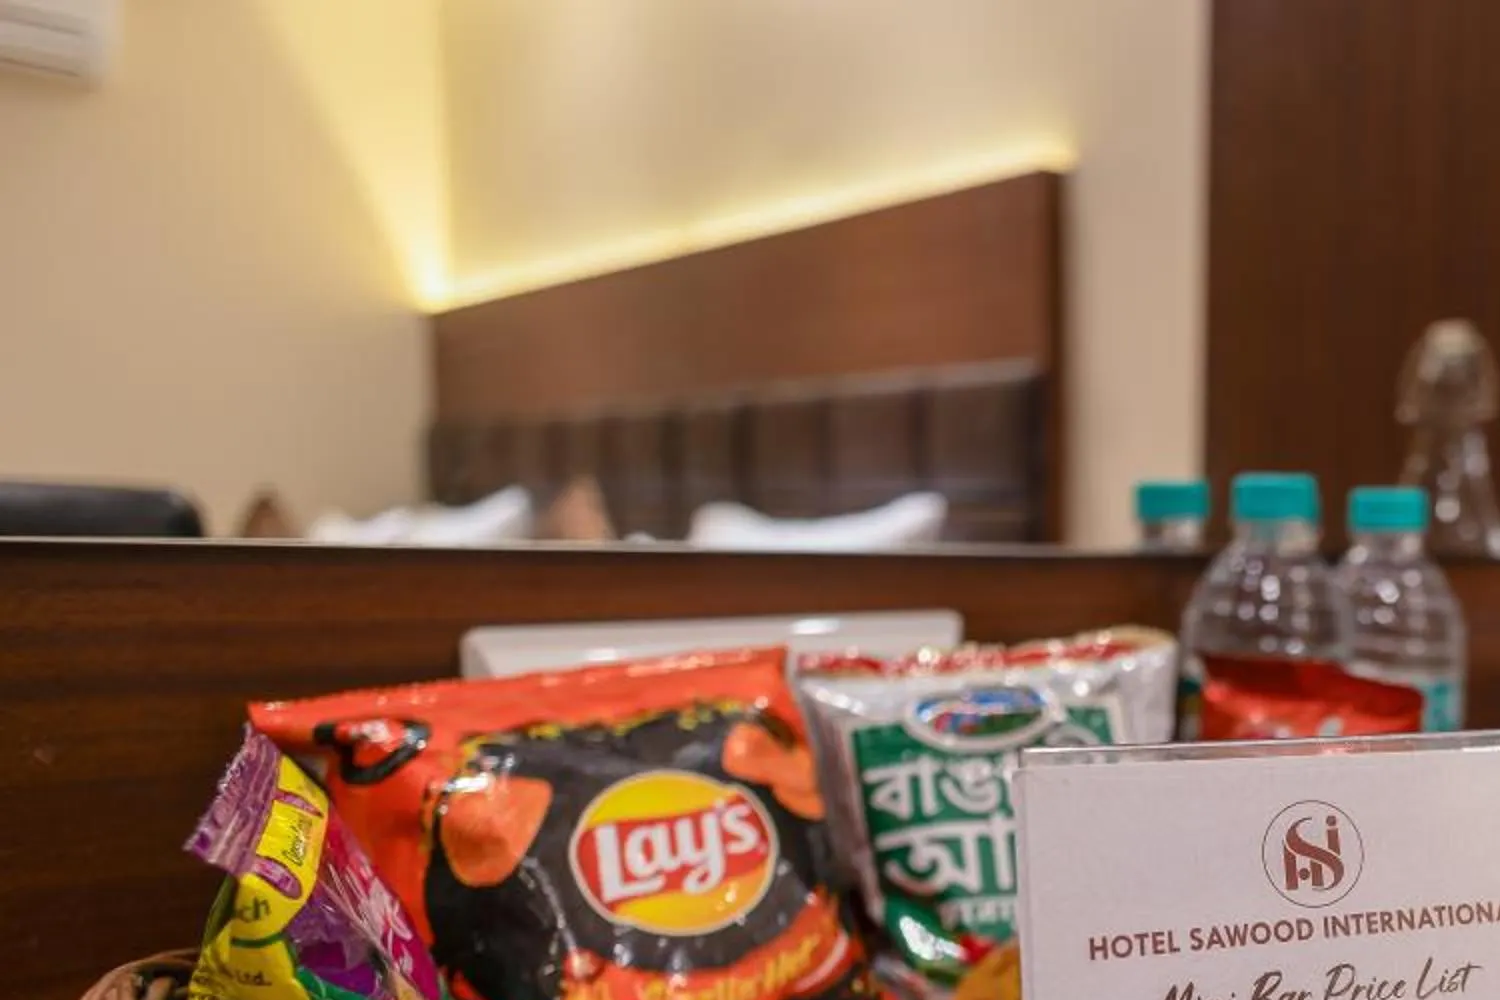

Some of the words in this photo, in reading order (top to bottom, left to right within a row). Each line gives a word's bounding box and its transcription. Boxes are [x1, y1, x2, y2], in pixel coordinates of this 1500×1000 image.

[592, 796, 768, 902] Lay's
[1089, 929, 1181, 961] HOTEL
[1189, 917, 1315, 952] SAWOOD
[1415, 956, 1482, 1000] List
